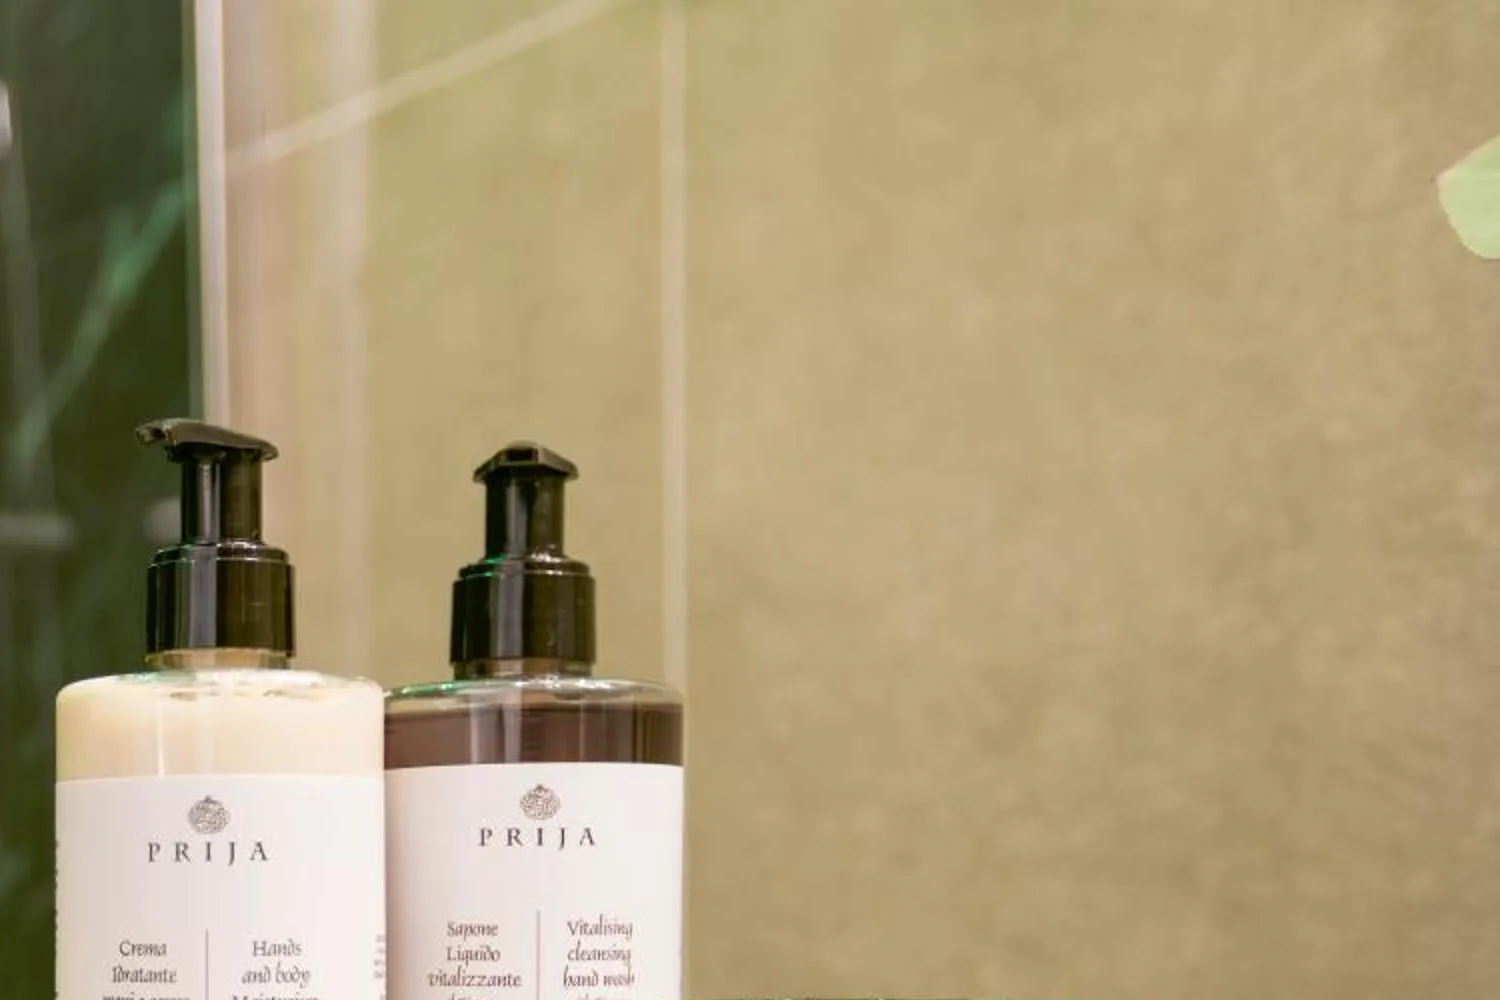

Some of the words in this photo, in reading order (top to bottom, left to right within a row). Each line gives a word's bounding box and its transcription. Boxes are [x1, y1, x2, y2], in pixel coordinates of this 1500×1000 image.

[479, 827, 596, 850] PRIJA
[148, 841, 269, 866] PRIJA
[446, 921, 499, 942] Sapone
[566, 913, 633, 941] Vitalising
[119, 938, 167, 957] Crema
[252, 938, 302, 957] Hands
[446, 943, 502, 967] Liquido
[566, 939, 632, 967] cleansing
[241, 964, 271, 984] and
[275, 959, 311, 989] body
[428, 964, 523, 988] vitalizzante
[563, 963, 599, 988] hand
